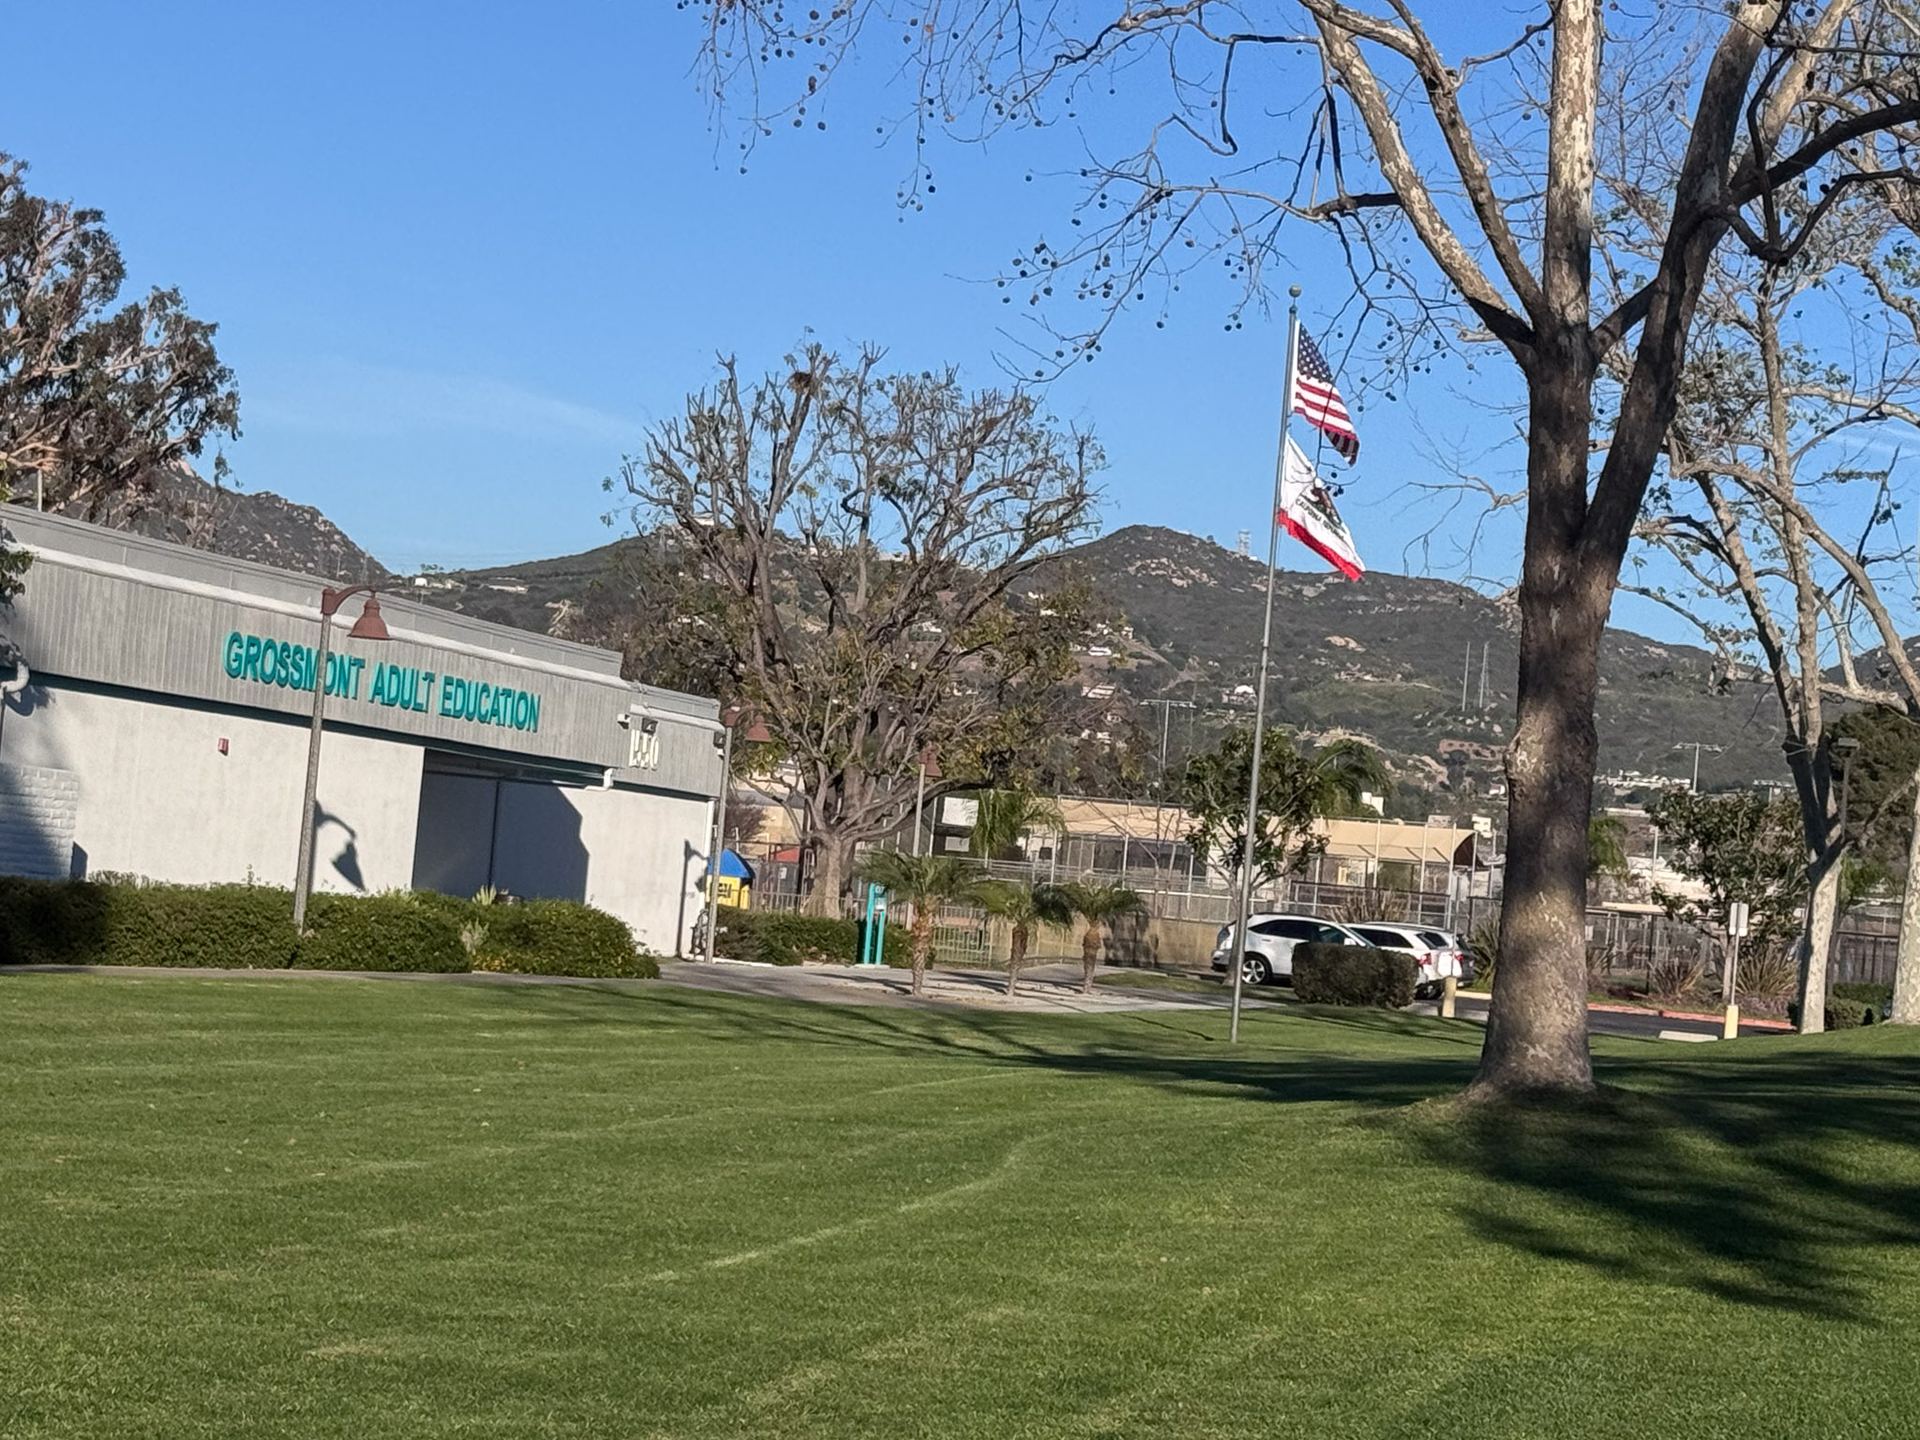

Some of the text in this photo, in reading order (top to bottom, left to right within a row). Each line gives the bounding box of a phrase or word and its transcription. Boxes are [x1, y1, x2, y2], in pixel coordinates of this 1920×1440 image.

[224, 631, 541, 732] GROSSMONT ADULT EDUCATION
